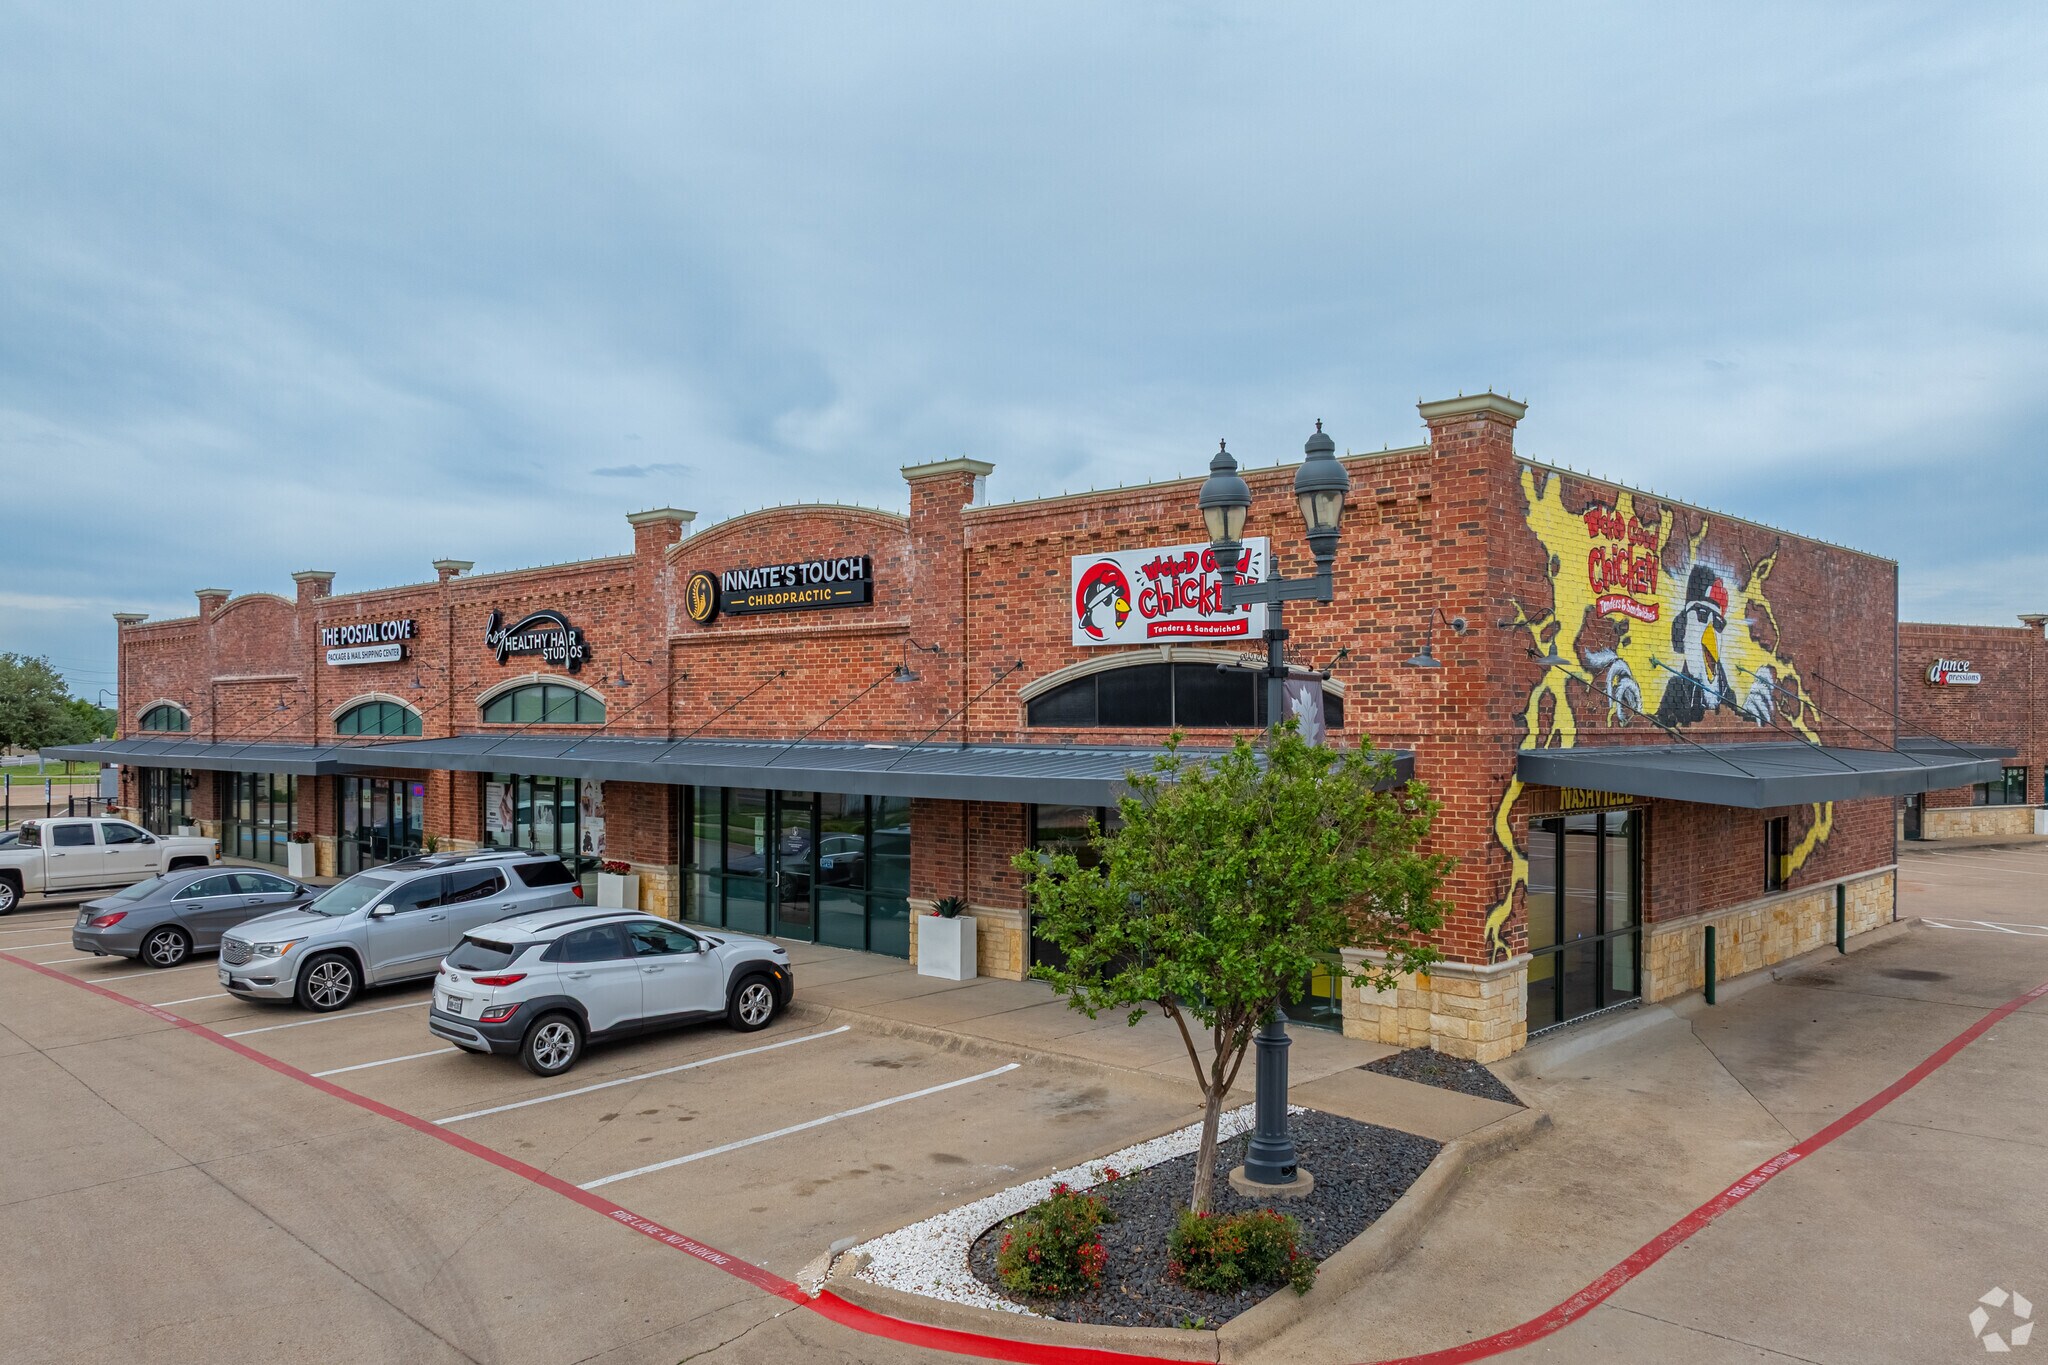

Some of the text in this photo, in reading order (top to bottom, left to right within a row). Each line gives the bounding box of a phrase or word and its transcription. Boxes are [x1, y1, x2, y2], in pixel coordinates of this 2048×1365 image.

[1201, 548, 1252, 573] Gd
[722, 557, 864, 591] INNATE'S TOUCH
[748, 589, 832, 606] CHIROPRACTIC
[321, 619, 410, 646] THE POSTAL COVE
[1153, 623, 1241, 634] Tenders & Sandwiches
[505, 633, 548, 651] HEALTHY
[328, 652, 346, 661] PACKAGE
[351, 651, 361, 660] MAIL
[362, 649, 382, 659] SHIPPING
[382, 648, 400, 657] CENTER
[1930, 658, 1970, 682] dance
[609, 1210, 731, 1265] FIRE LANE NO PARKING
